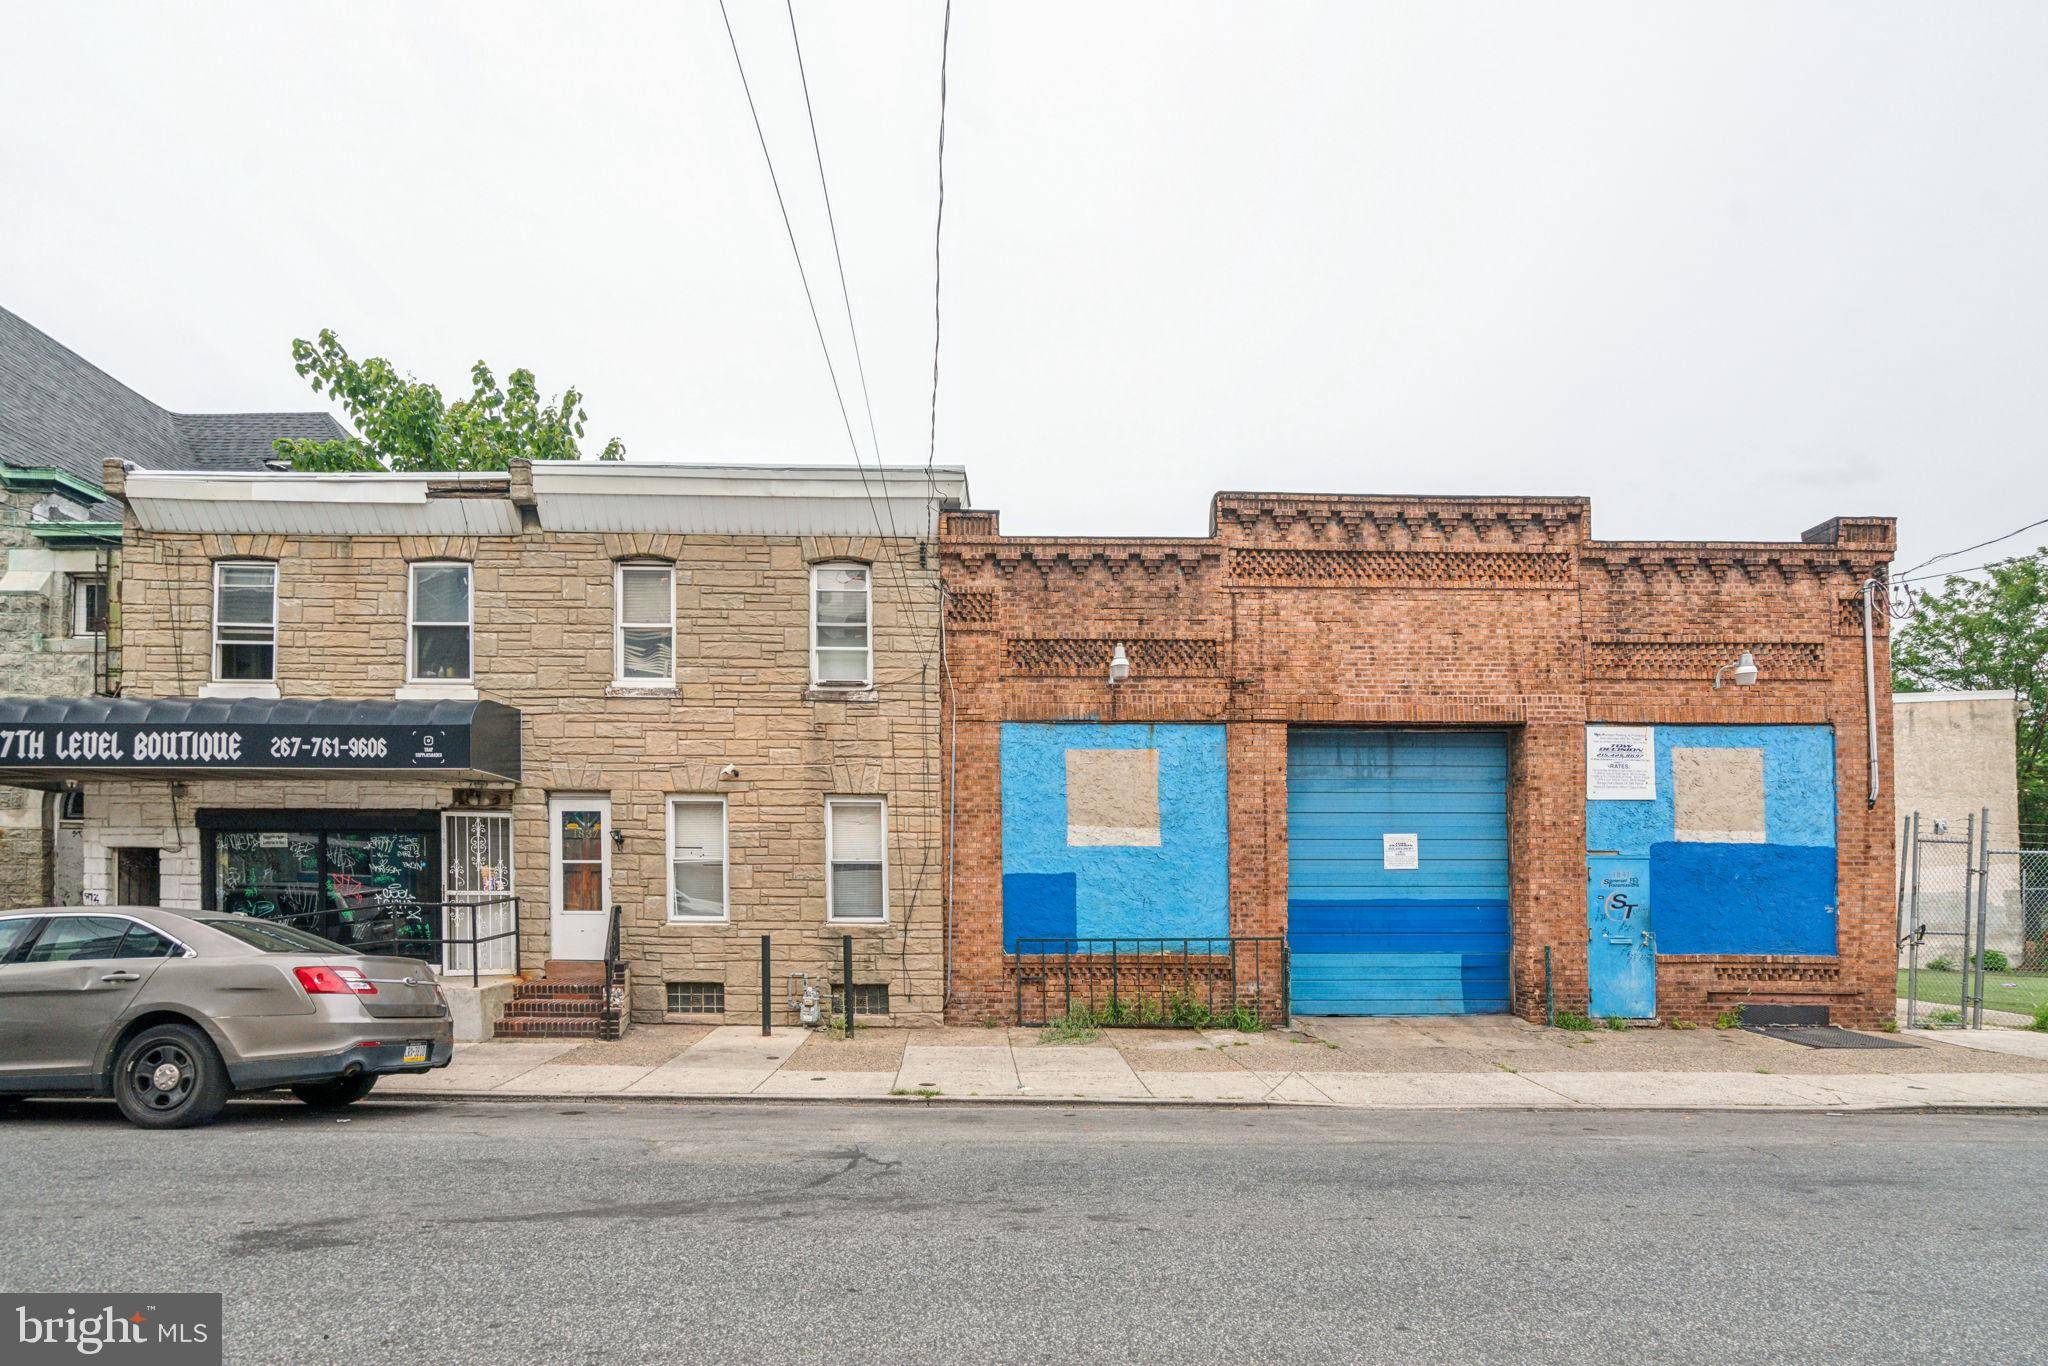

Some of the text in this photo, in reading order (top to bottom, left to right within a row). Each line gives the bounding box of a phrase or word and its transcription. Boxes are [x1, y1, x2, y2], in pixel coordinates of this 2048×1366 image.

[0, 730, 242, 762] 7TH LEVEL BOUTIQUE
[270, 736, 388, 758] 267-761-9606
